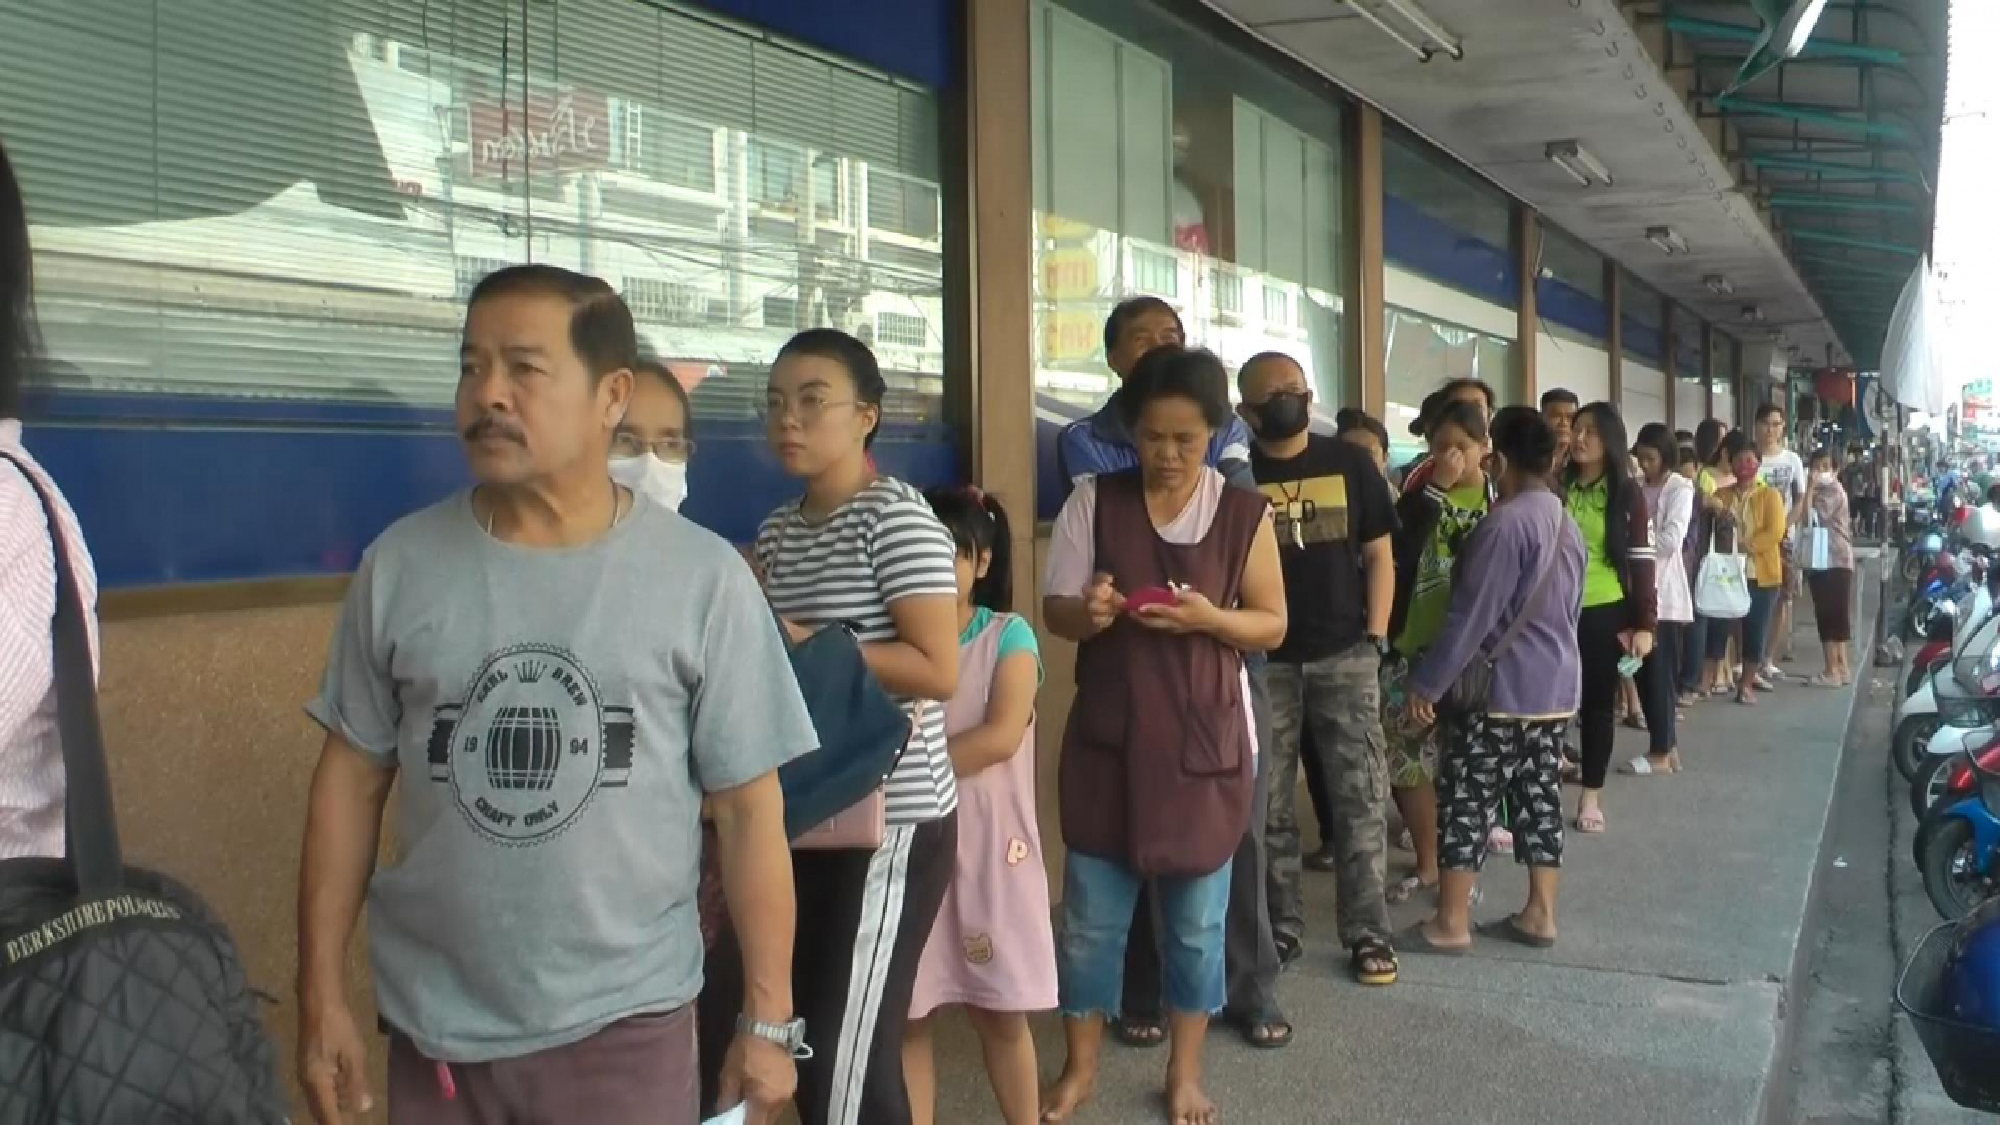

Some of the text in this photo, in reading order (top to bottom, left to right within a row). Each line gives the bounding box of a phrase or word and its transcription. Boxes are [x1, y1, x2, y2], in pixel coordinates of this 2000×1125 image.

[552, 667, 588, 706] BREW
[463, 735, 479, 754] 19
[475, 796, 558, 828] CRAFT ONLY
[1004, 837, 1030, 867] P
[6, 900, 107, 965] BERKSHIRE
